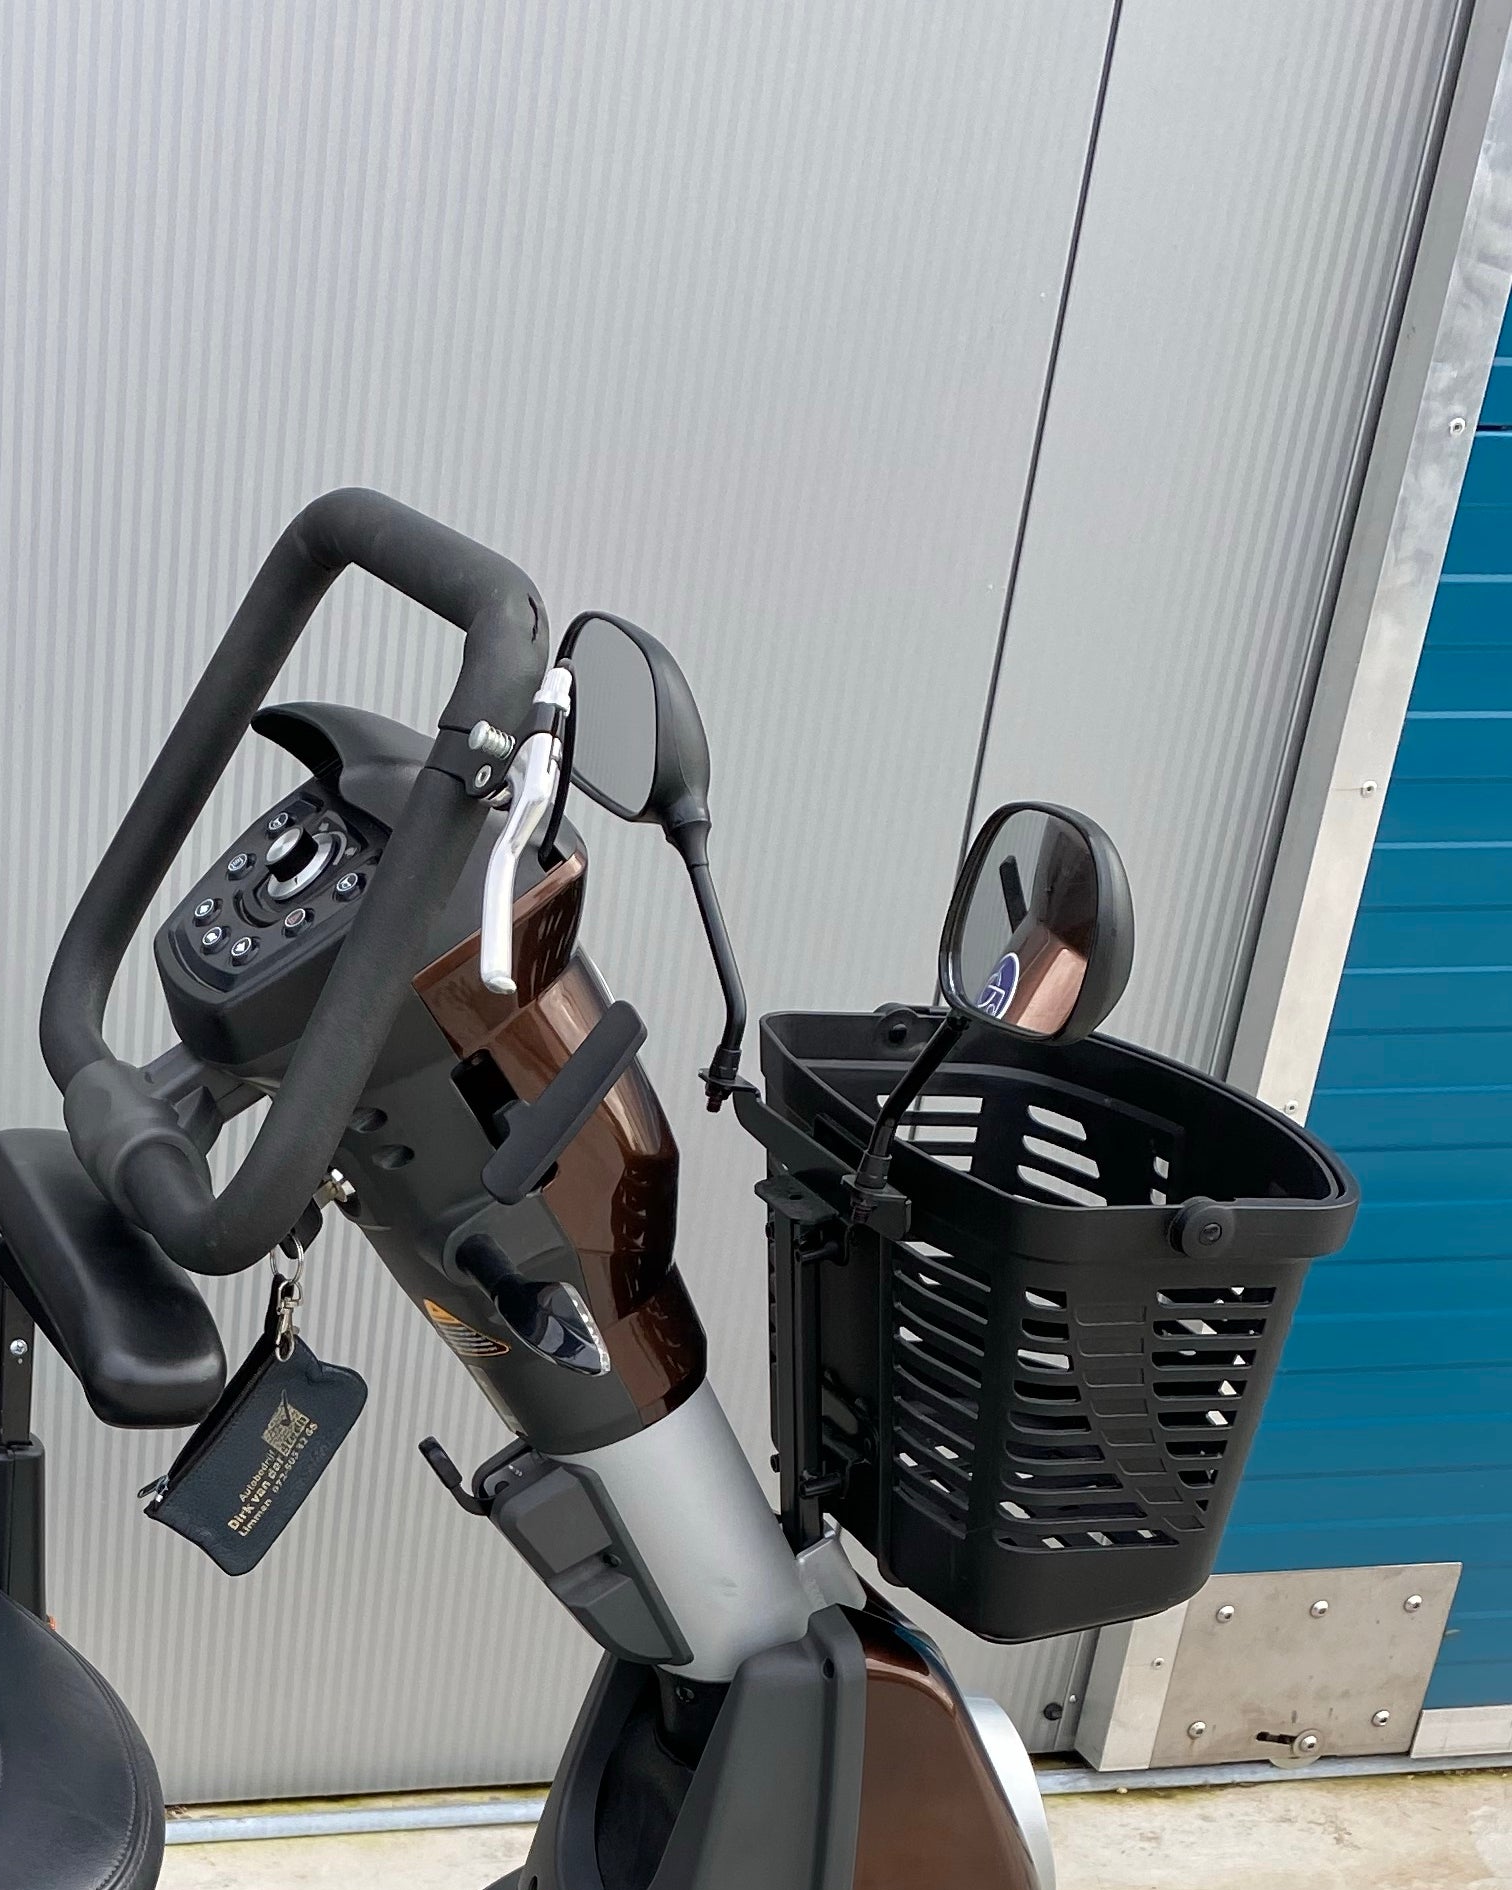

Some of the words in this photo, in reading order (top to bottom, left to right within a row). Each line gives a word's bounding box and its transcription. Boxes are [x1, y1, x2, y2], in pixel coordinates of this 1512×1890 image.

[227, 1503, 255, 1531] Dirk
[251, 1480, 271, 1504] van
[268, 1456, 284, 1479] der
[238, 1498, 273, 1537] Limmen
